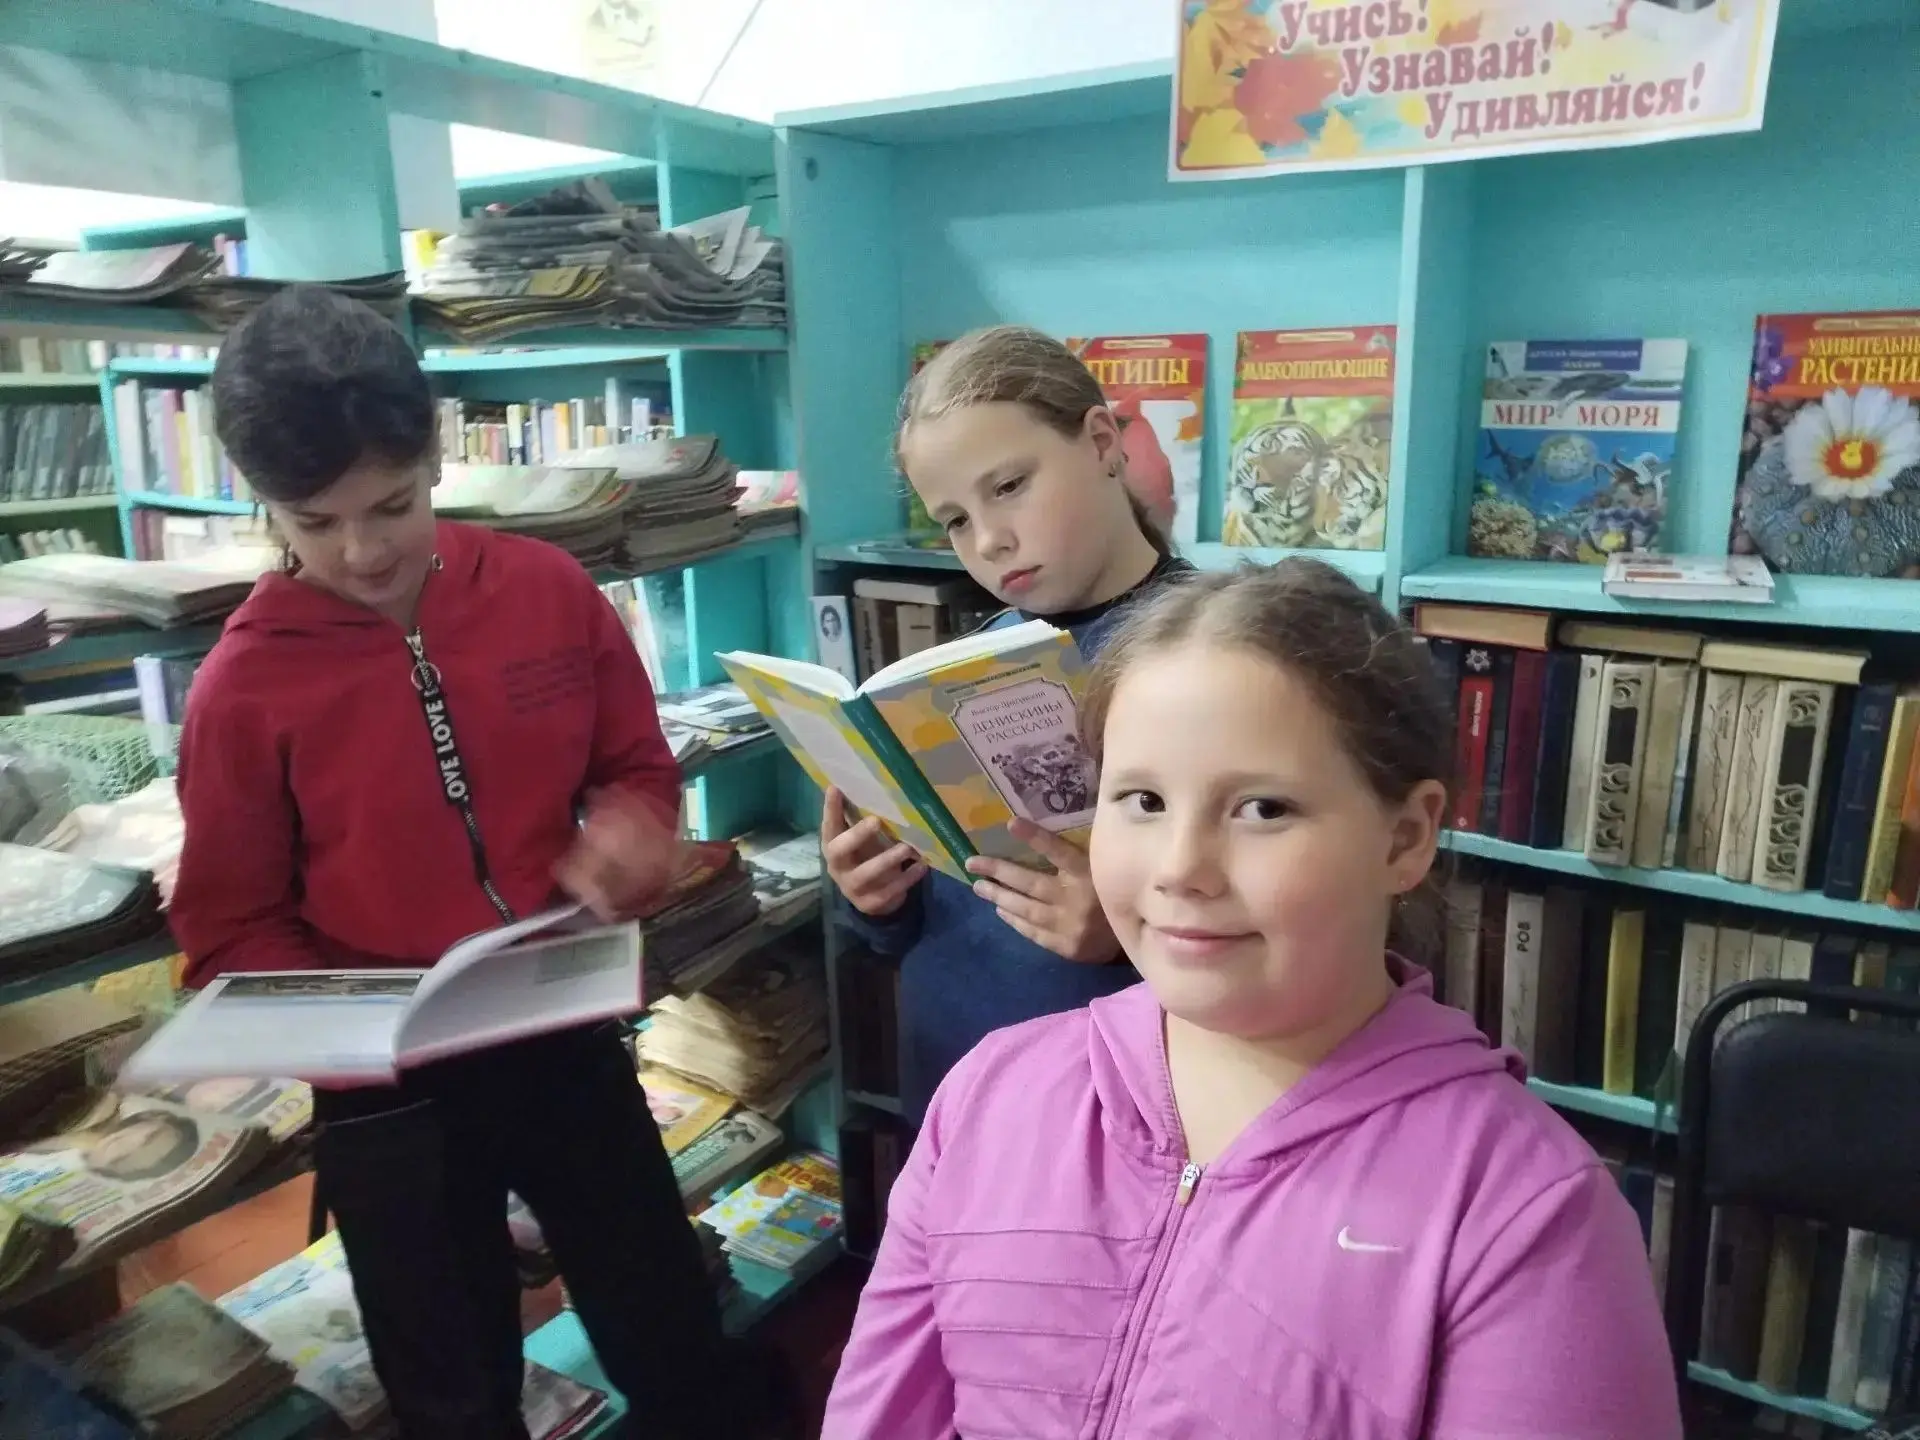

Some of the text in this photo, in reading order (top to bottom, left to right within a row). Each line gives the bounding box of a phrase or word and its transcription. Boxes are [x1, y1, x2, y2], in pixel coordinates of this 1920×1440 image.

[1278, 0, 1428, 51] Учись!
[1339, 22, 1554, 97] Узнавай!
[1424, 61, 1706, 142] Удивляйся!
[1492, 403, 1661, 427] МИР МОРЯ
[425, 699, 455, 754] LOVE
[971, 700, 1064, 735] ДЕНИСКИНЫ
[985, 715, 1064, 744] РАССКАЗЫ
[440, 756, 469, 802] OVE
